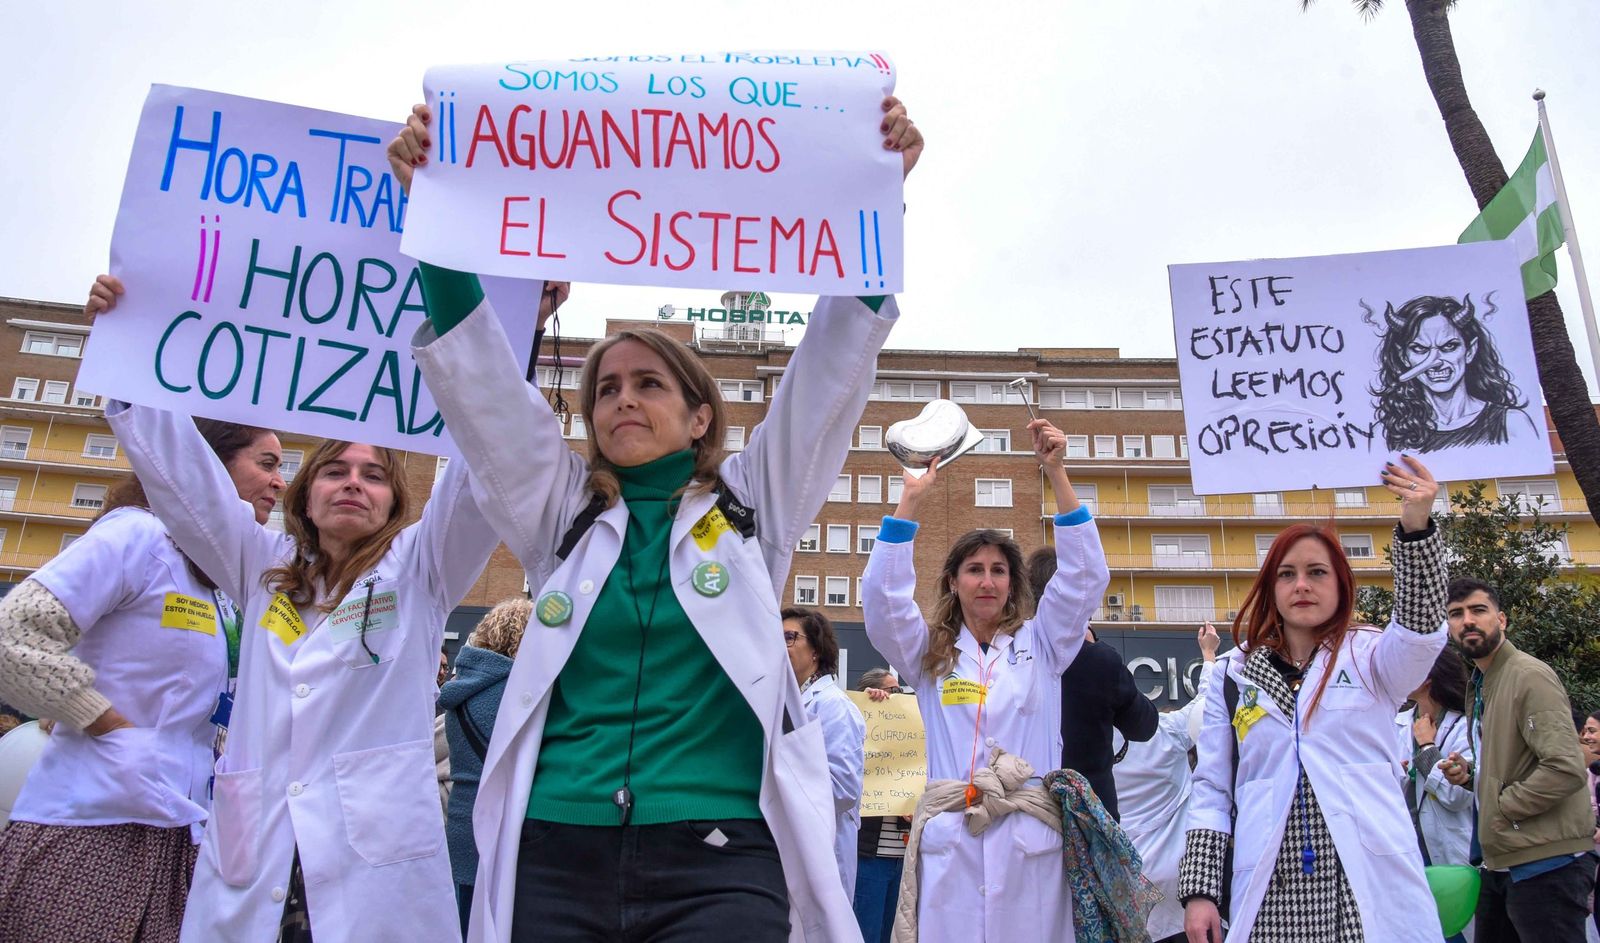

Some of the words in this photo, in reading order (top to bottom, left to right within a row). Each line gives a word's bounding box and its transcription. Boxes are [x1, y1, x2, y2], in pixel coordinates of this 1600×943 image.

[500, 63, 619, 94] SOMOS
[648, 73, 707, 98] LOS
[160, 104, 306, 218] HORA
[499, 195, 567, 260] EL
[1208, 275, 1294, 316] ESTE
[686, 307, 812, 326] HOSPITA
[1189, 323, 1345, 360] ESTATUTO
[154, 310, 447, 438] COTIZAD
[1212, 367, 1345, 405] LEEMOS
[1198, 411, 1377, 457] OPRESIÓN
[164, 605, 187, 614] ESTOY
[187, 608, 196, 616] EN
[175, 597, 188, 605] SOY
[277, 598, 300, 623] MÉDICO
[278, 610, 301, 636] HUELGA
[871, 724, 918, 742] GUARDIAS
